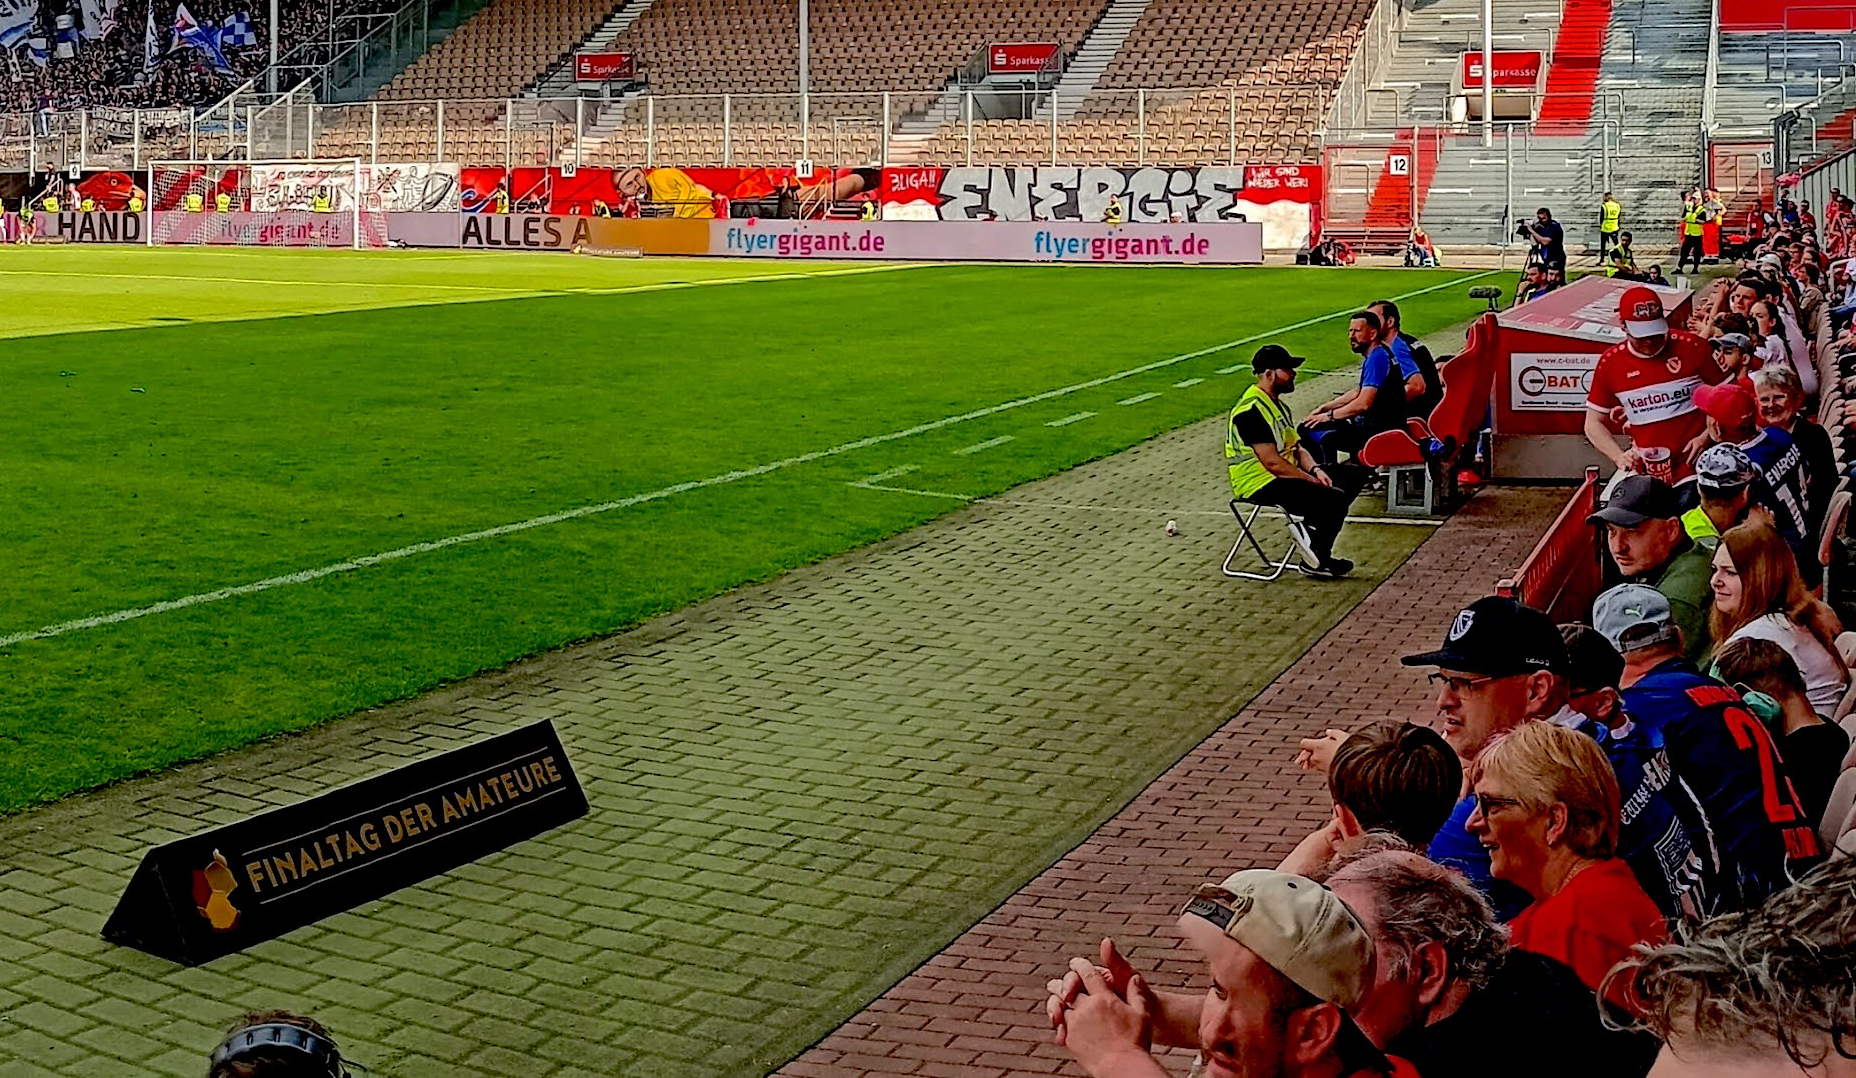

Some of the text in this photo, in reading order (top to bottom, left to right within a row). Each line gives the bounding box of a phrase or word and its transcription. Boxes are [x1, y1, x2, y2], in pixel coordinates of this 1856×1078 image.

[1393, 158, 1406, 172] 12
[1763, 152, 1771, 165] 13
[71, 165, 79, 178] 9
[564, 164, 574, 174] 10
[800, 162, 810, 175] 11
[1275, 167, 1300, 176] SIND
[58, 212, 140, 239] HAND
[462, 216, 562, 247] ALLES
[727, 227, 885, 255] flyergigant.de
[1035, 230, 1210, 263] flyergigant.de
[1547, 374, 1581, 390] BAT
[1628, 386, 1691, 409] karton.eu
[245, 756, 562, 893] FINALTAG DER AMATEURE
